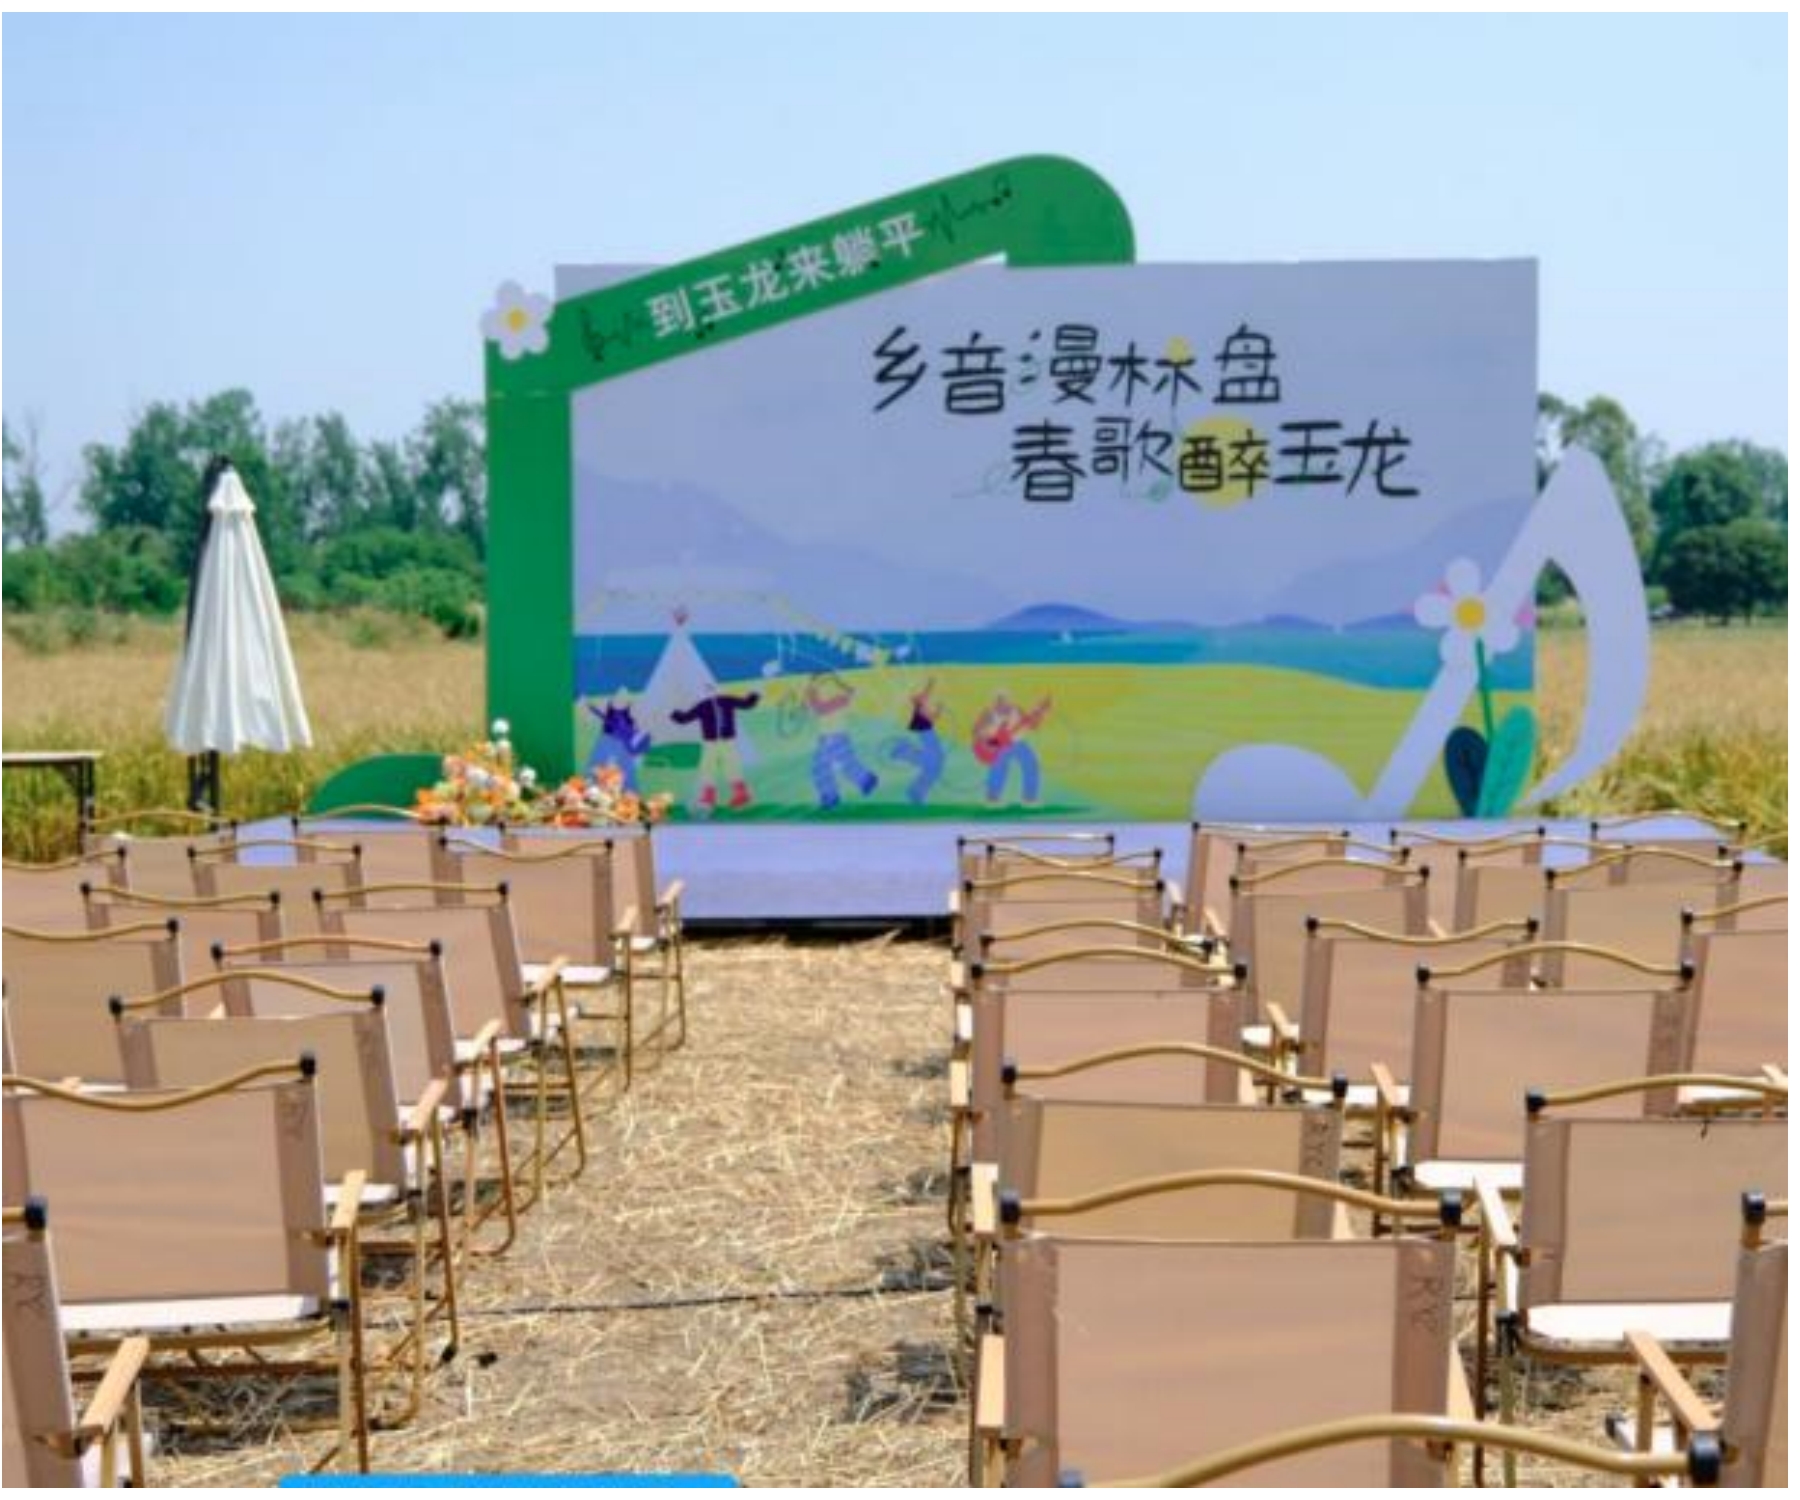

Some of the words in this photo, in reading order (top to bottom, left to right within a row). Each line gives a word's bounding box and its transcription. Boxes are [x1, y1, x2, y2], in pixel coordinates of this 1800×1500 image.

[646, 211, 925, 338] 到玉龙来躺平
[872, 323, 1282, 416] 乡音漫林盘
[1011, 417, 1420, 502] 春歌醉玉龙
